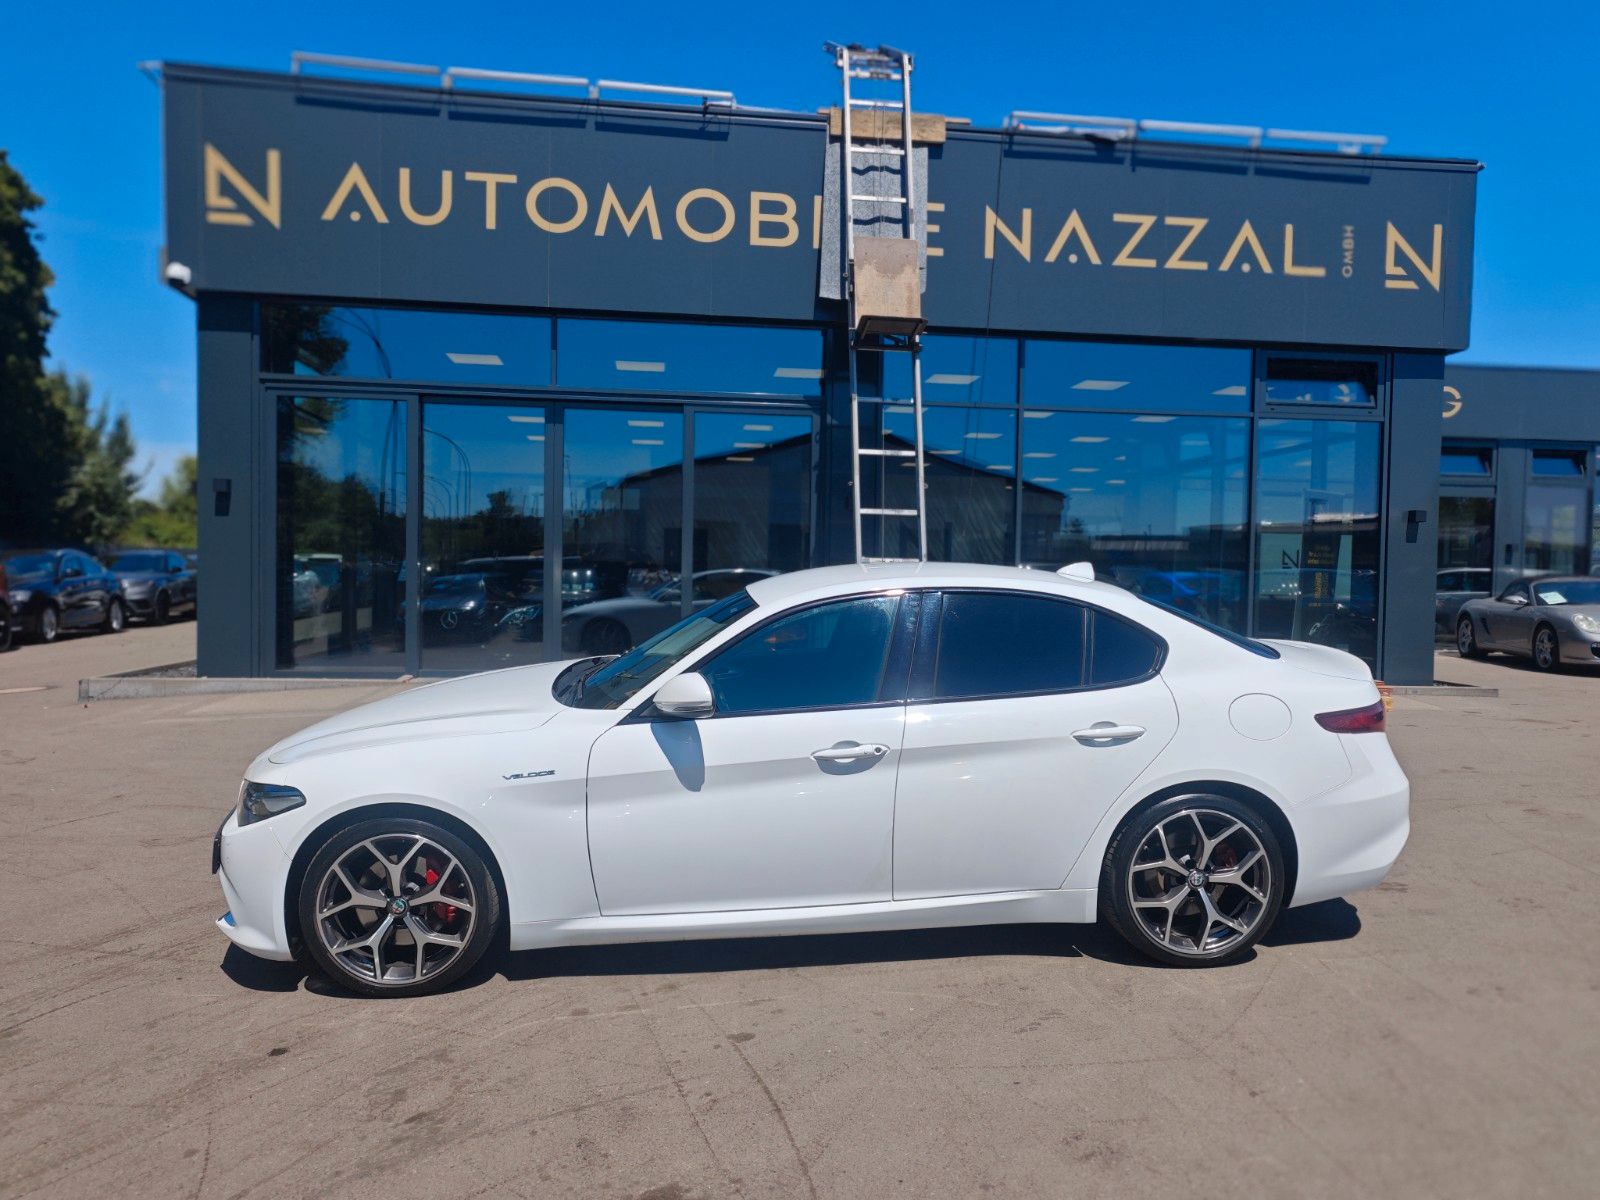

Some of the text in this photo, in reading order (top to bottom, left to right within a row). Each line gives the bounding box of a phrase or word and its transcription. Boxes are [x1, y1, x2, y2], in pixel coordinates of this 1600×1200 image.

[320, 161, 1327, 278] AUTOMOBI NAZZAL
[502, 769, 556, 781] VELOCE
